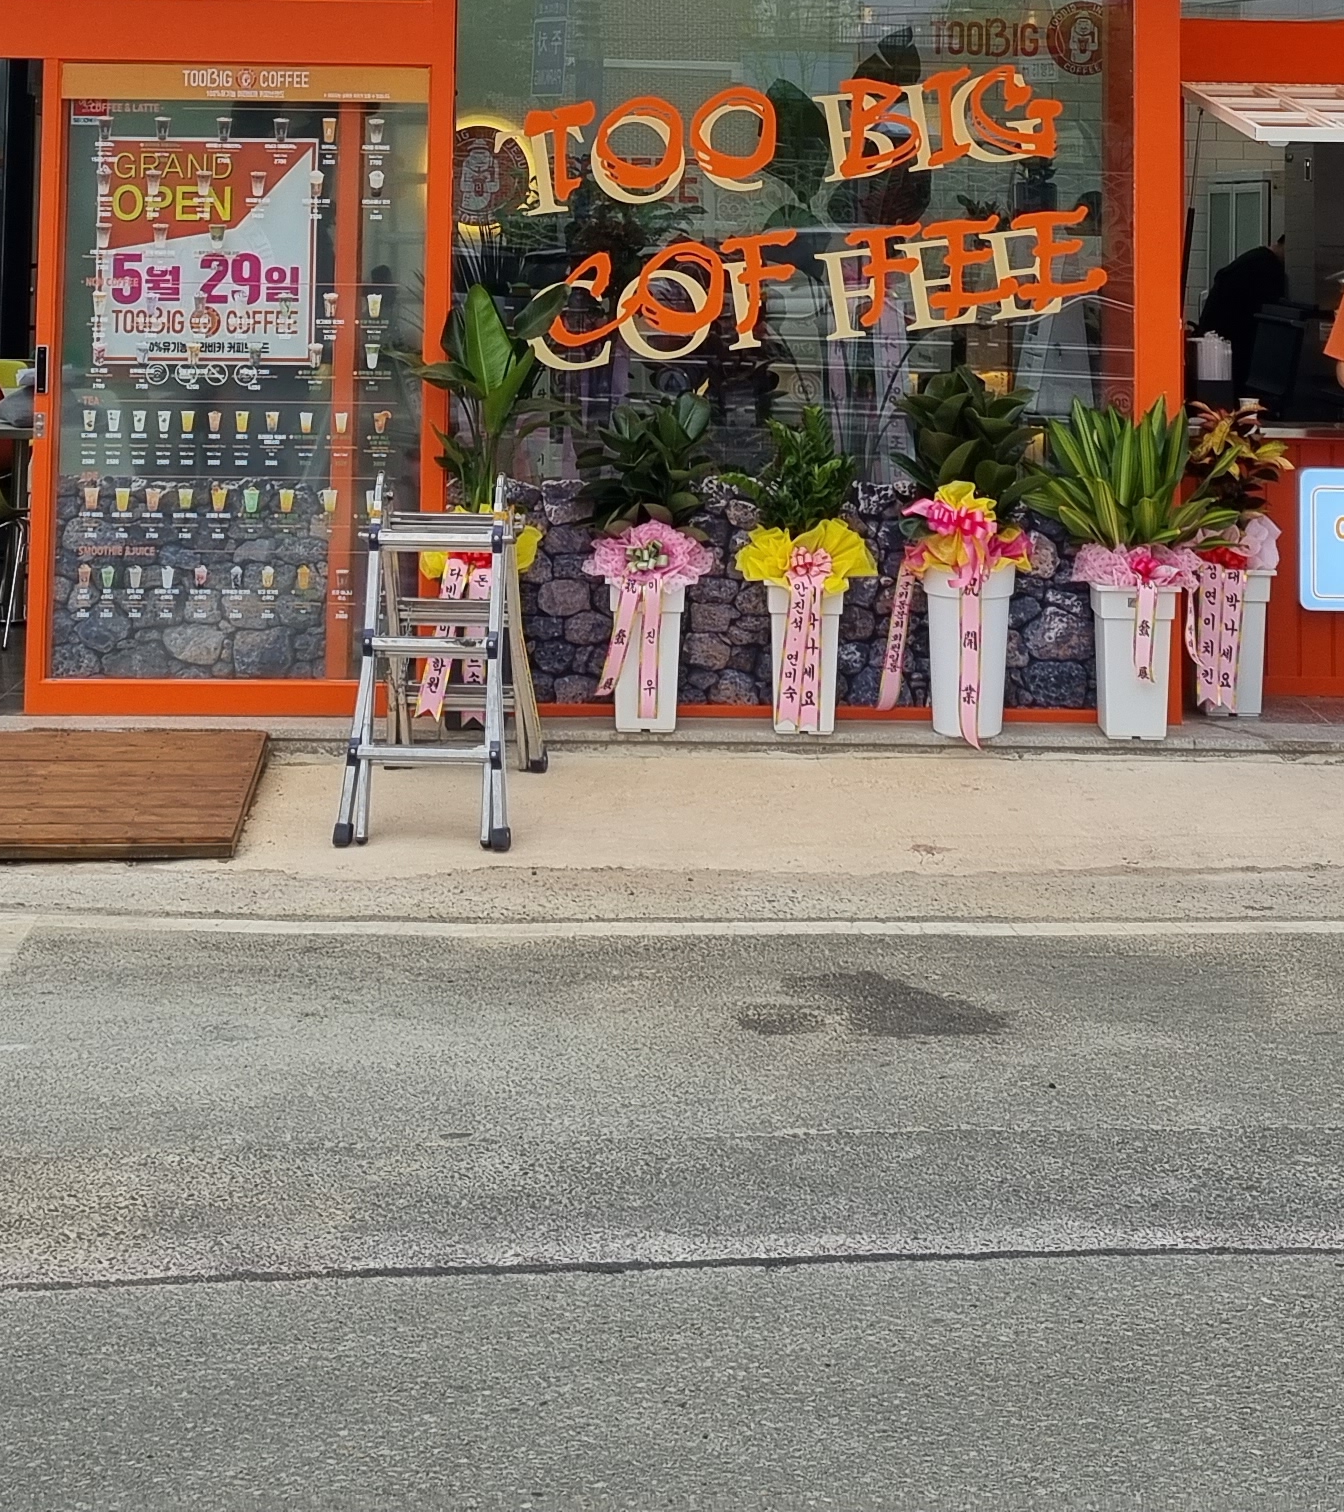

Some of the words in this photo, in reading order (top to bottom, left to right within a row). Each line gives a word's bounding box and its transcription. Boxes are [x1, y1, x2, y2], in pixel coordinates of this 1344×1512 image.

[930, 17, 1039, 57] TOOBIG
[182, 67, 233, 88] TOOBIG
[259, 71, 310, 88] COFFEE
[133, 103, 160, 113] LATTE
[114, 151, 233, 180] GRAND
[112, 184, 233, 222] OPEN
[111, 251, 181, 305] 5월
[199, 251, 300, 305] 29일
[82, 395, 100, 406] TEA
[78, 545, 123, 557] SMOOTHIE
[474, 574, 489, 587] 돈
[643, 577, 657, 698] 이진우
[1220, 570, 1241, 689] 대박나세요
[783, 650, 799, 703] 연미숙
